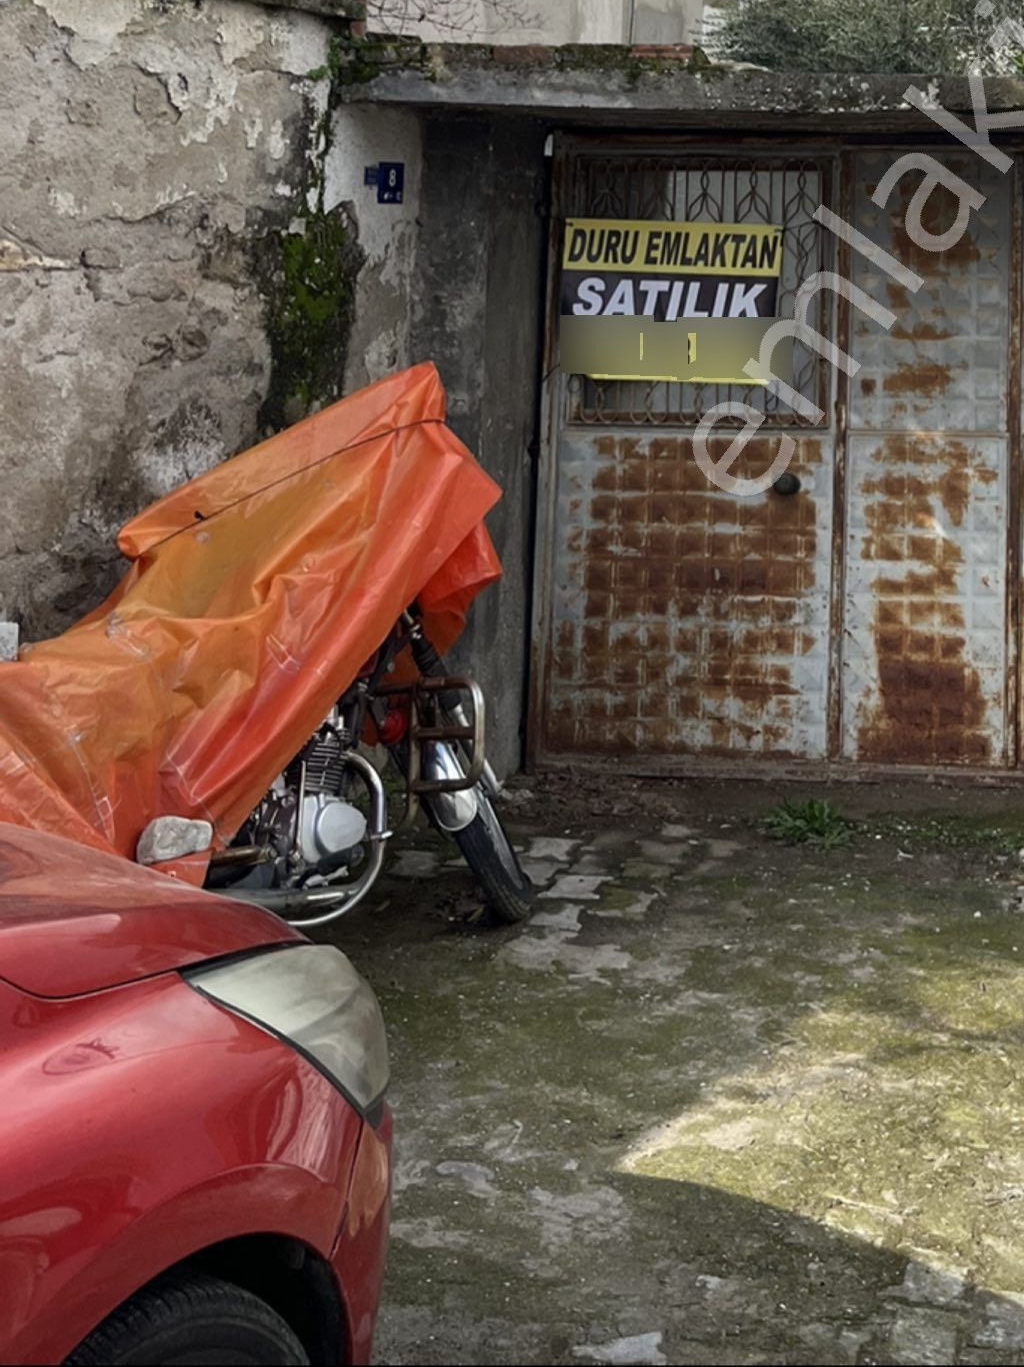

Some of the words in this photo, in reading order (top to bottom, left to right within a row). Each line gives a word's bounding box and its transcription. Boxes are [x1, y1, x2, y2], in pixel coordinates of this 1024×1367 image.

[389, 169, 397, 187] 8
[568, 228, 639, 265] DURU
[644, 230, 779, 269] EMLAKTAN
[572, 276, 767, 321] SATILIK
